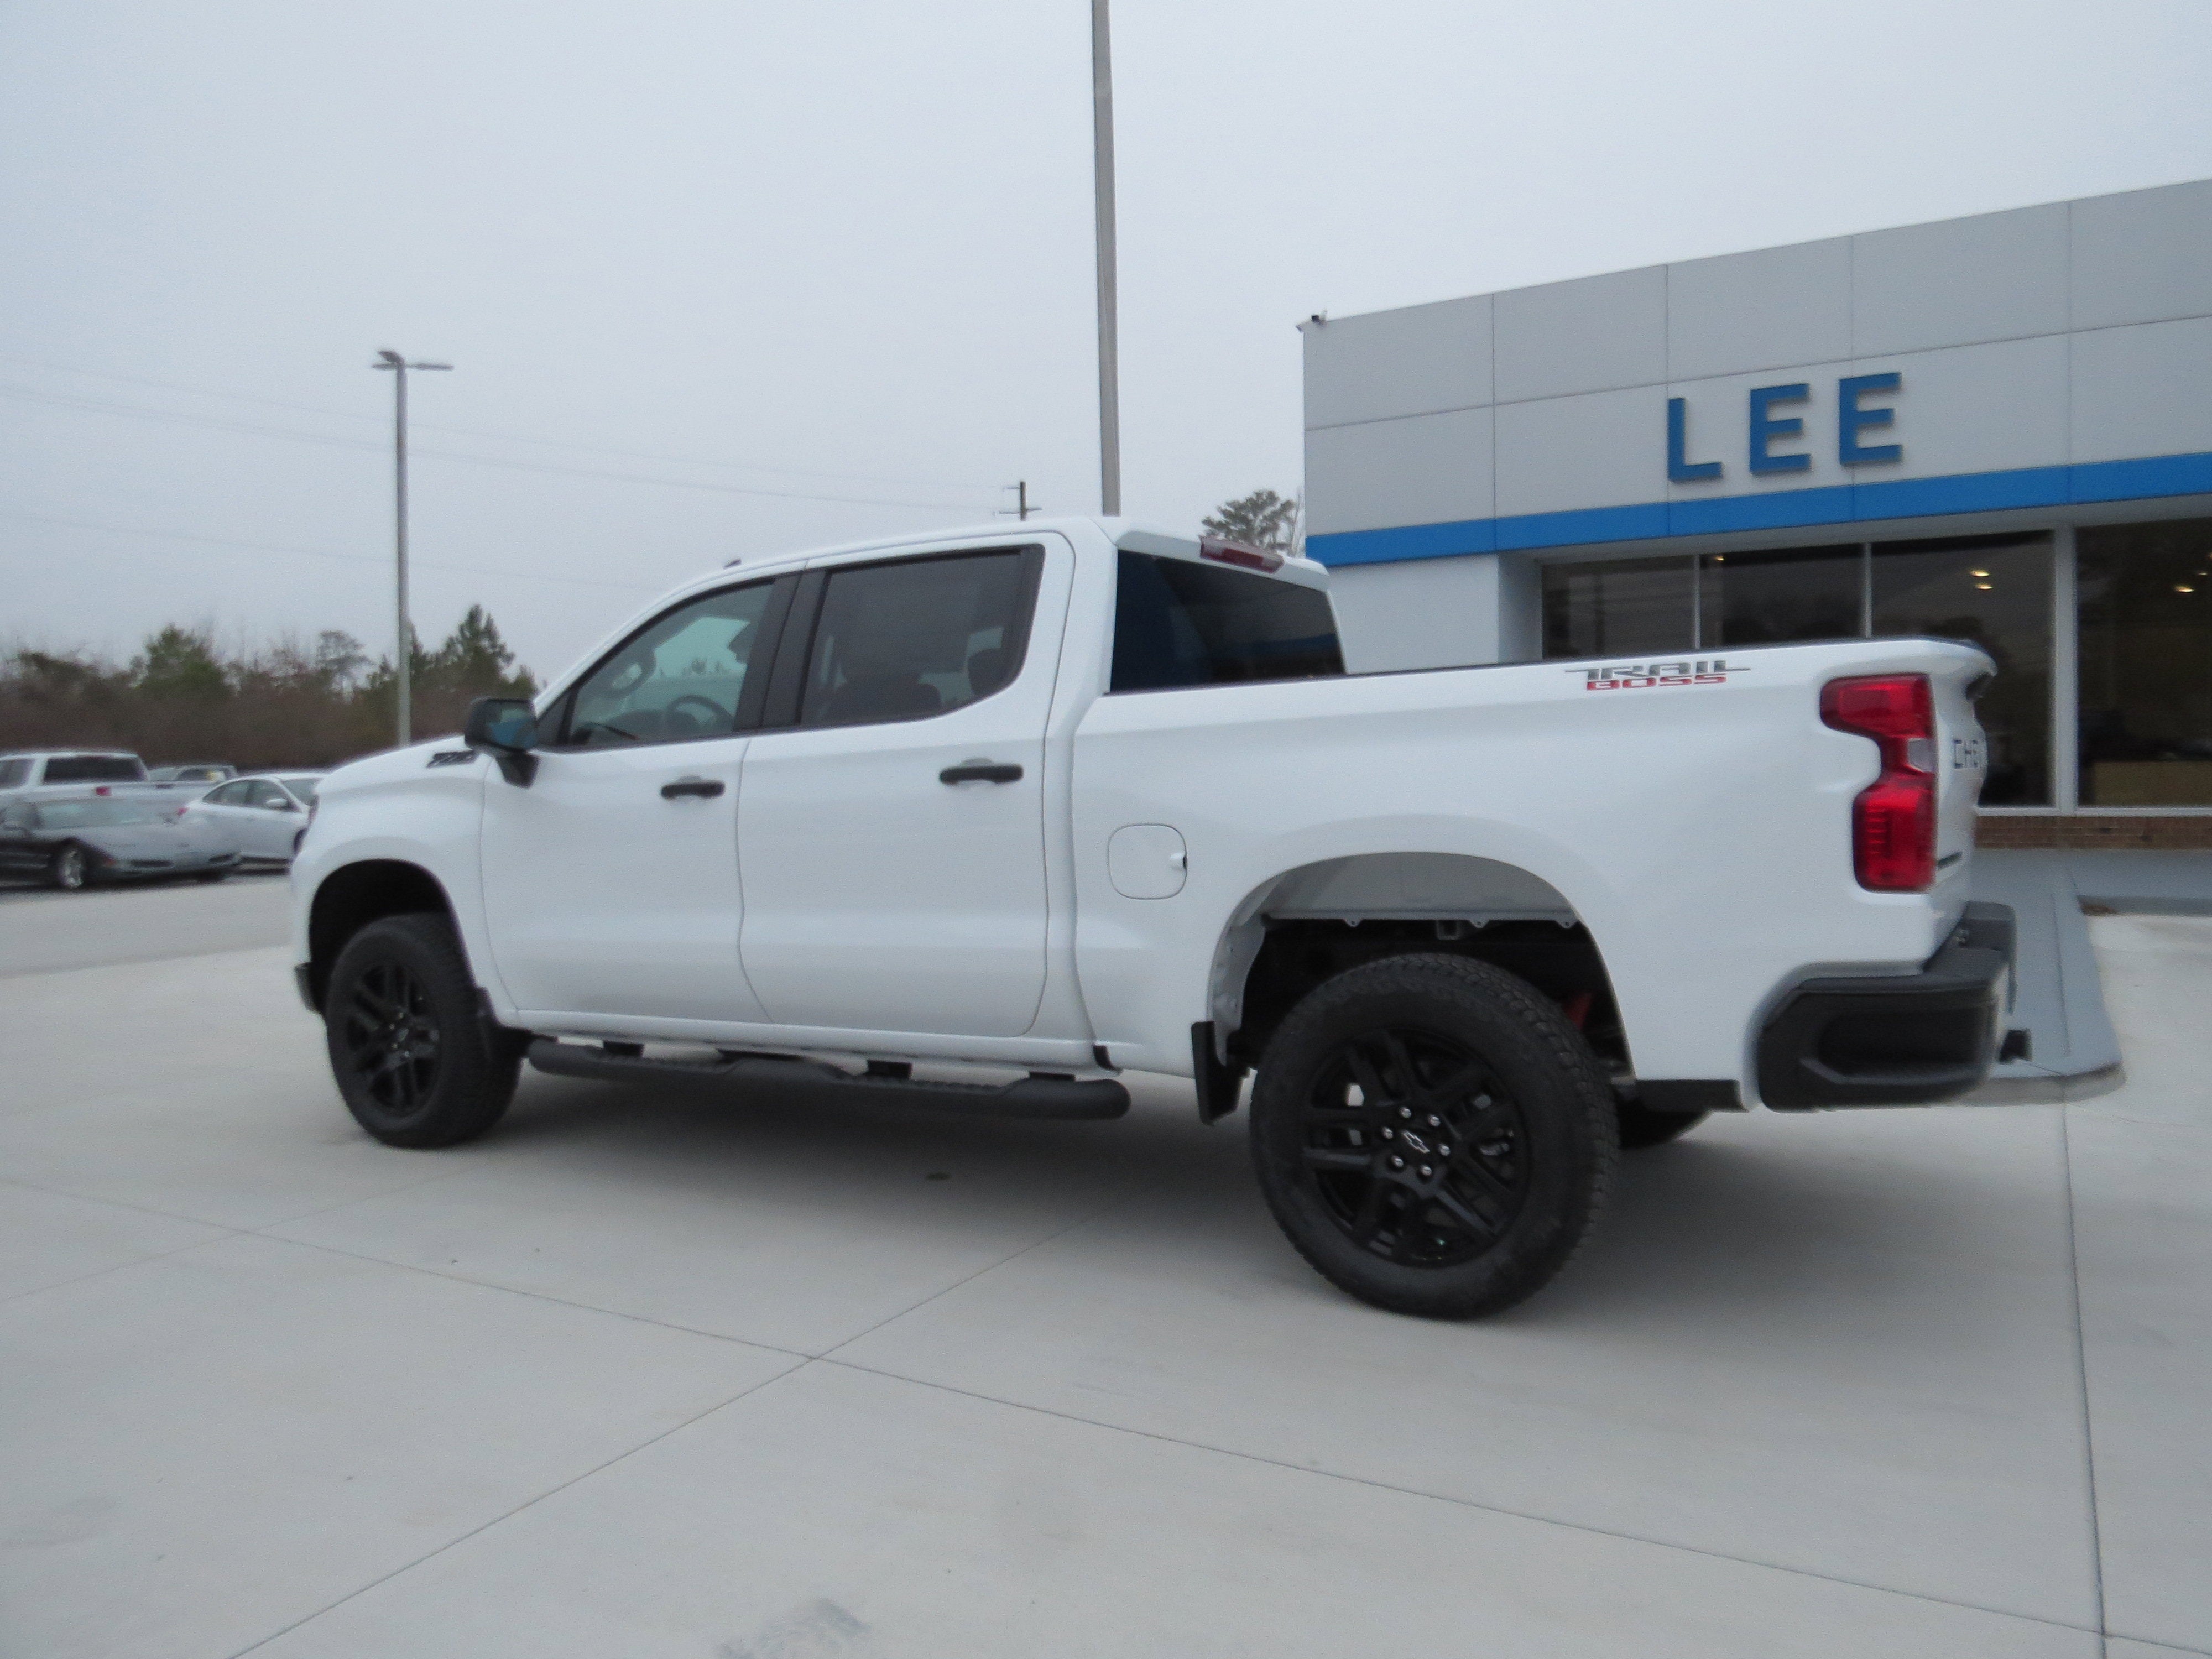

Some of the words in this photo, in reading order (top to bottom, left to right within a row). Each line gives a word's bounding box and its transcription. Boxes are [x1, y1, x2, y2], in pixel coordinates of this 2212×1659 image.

[1667, 372, 1902, 482] LEE
[1565, 660, 1751, 681] TRAIL
[1586, 673, 1728, 691] BOSS
